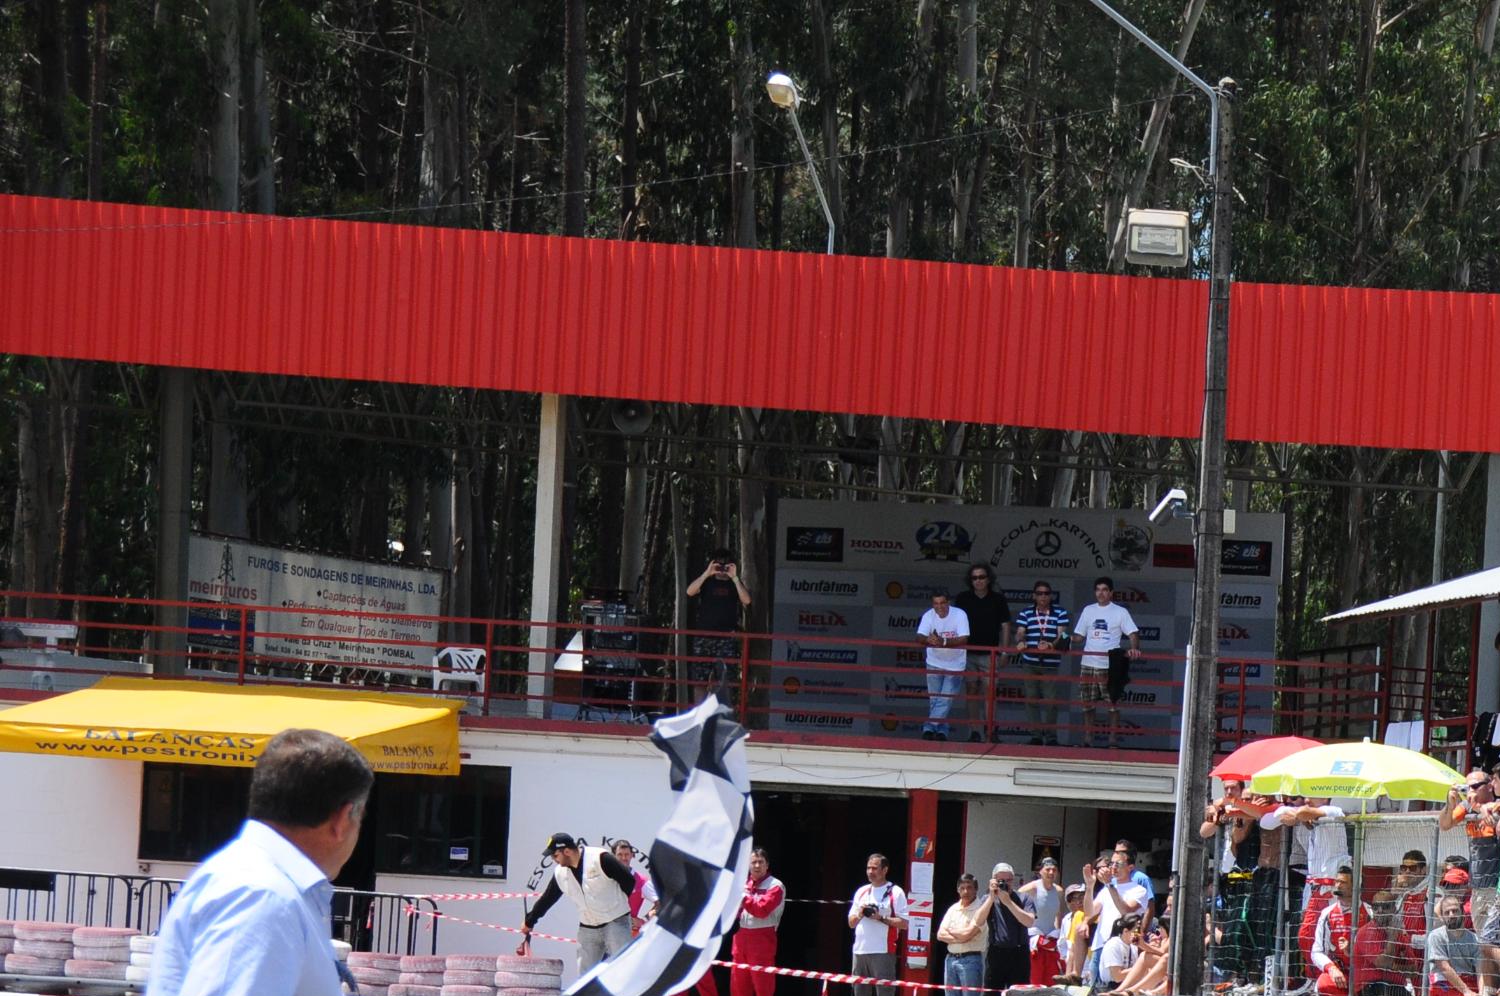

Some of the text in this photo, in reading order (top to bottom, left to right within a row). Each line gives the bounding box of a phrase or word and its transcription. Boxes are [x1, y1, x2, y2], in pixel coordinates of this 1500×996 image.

[850, 539, 904, 550] HONDA
[990, 518, 1105, 569] ESCOLA KARTING
[1018, 558, 1080, 569] EUROINDY
[247, 556, 280, 572] FUROS
[282, 563, 288, 573] E
[291, 565, 348, 584] SONDAGENS
[351, 573, 364, 585] DE
[418, 583, 438, 596] LDA.
[322, 589, 406, 612] Captações de Águas
[301, 616, 421, 641] Em Qualquer Tipo de Terreno
[799, 613, 847, 626] HELIX
[313, 639, 332, 648] Cruz
[338, 641, 375, 654] Meirinhas
[382, 647, 415, 659] POMBAL
[801, 650, 855, 660] MICHELIN
[85, 729, 256, 749] BALANÇAS
[382, 746, 434, 758] BALANÇAS
